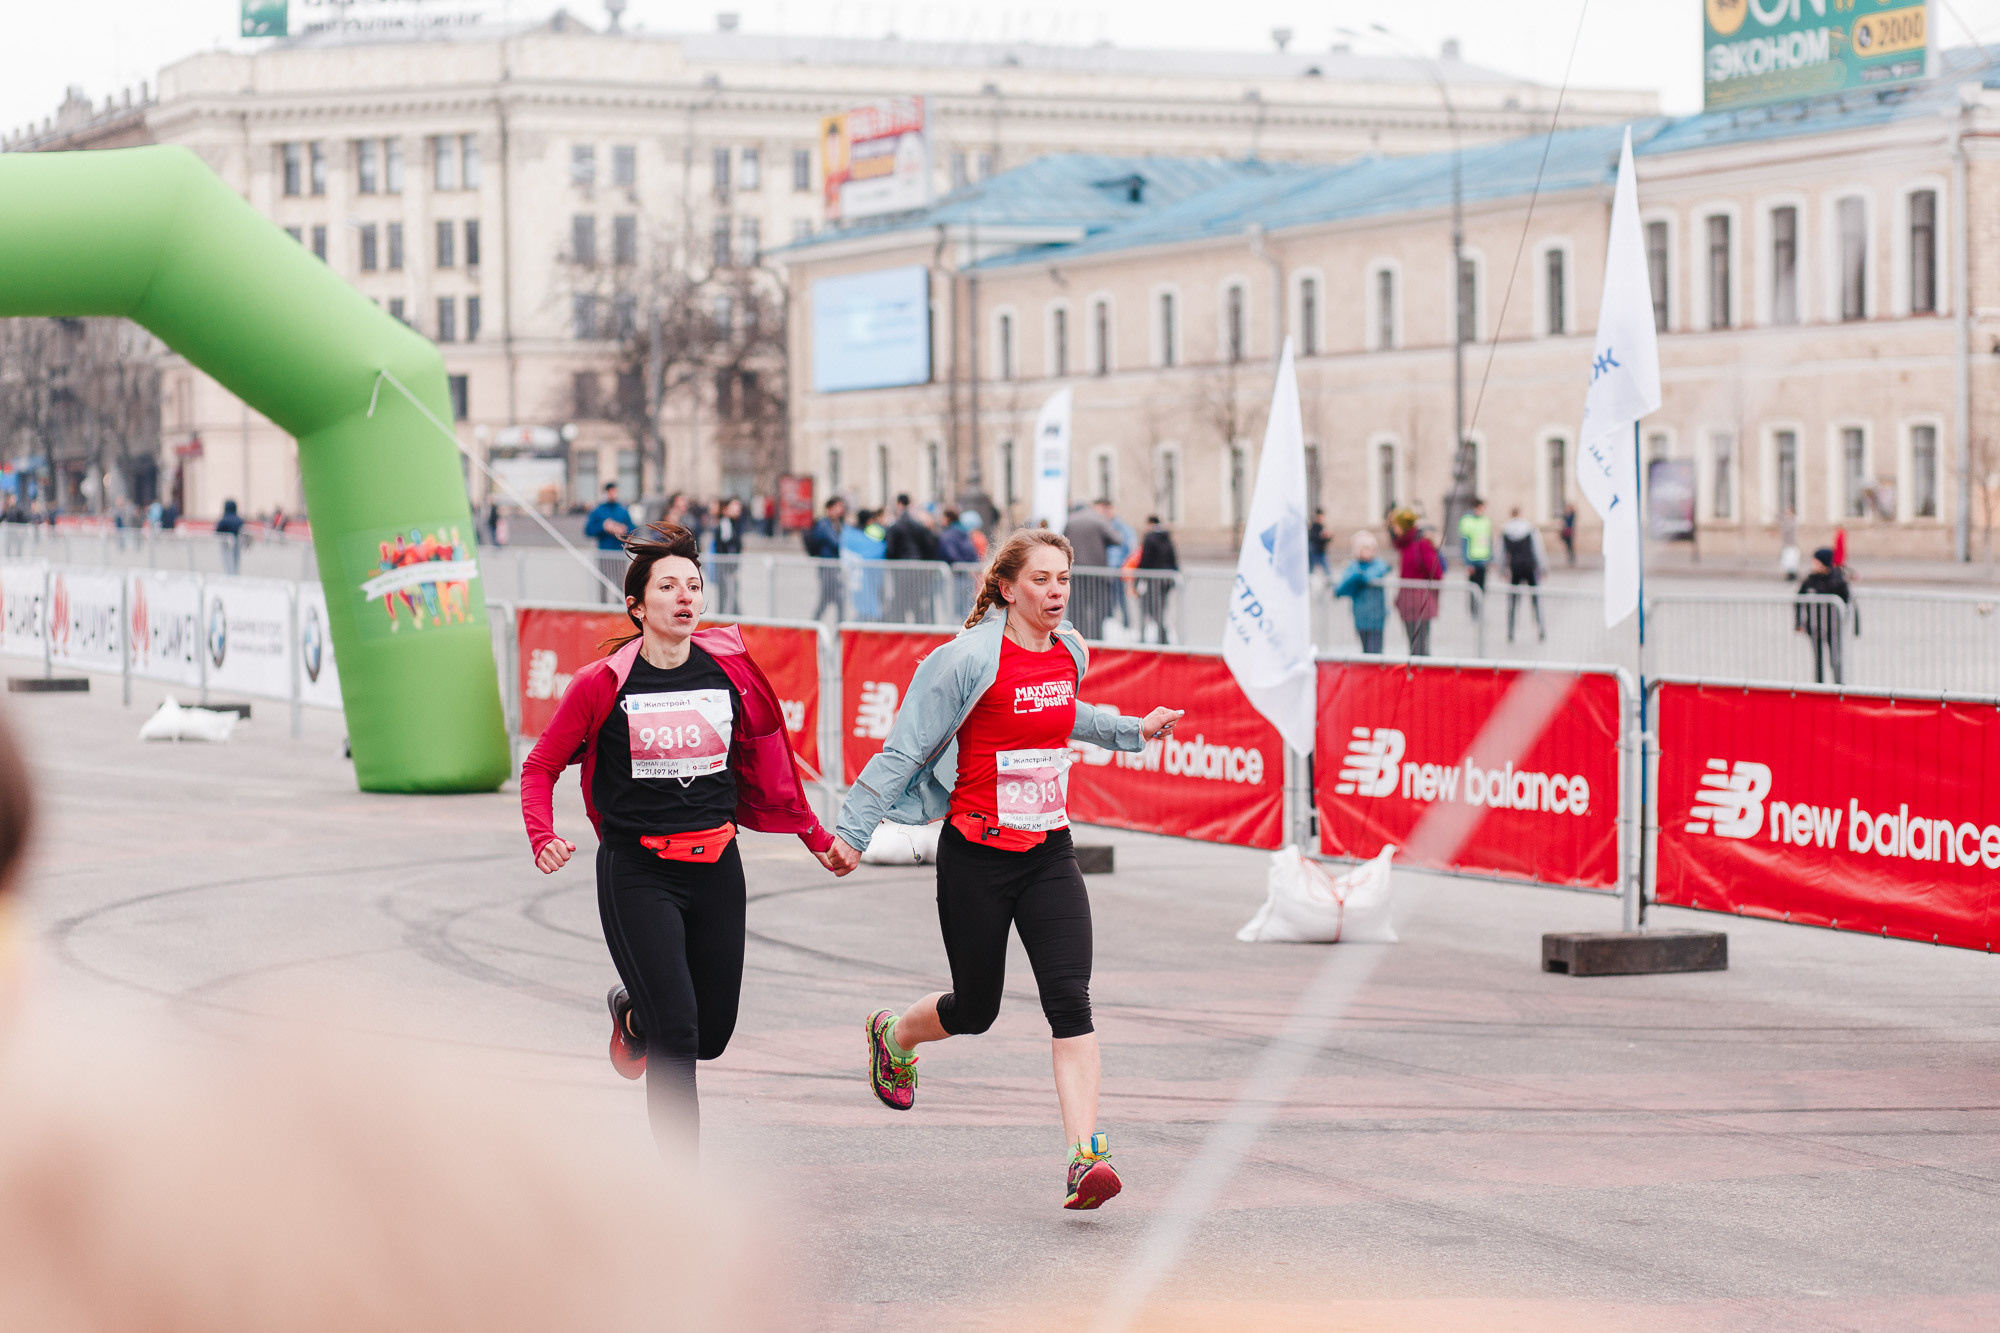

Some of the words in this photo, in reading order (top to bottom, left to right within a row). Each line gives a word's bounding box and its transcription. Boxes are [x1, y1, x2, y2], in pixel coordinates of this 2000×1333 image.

[643, 699, 691, 708] Жилстрой-1
[639, 724, 702, 751] 9313
[1164, 732, 1264, 785] balance
[1005, 780, 1057, 805] 9313
[1402, 762, 1461, 803] new
[1464, 756, 1590, 816] balance
[1769, 801, 1842, 849] new
[1848, 797, 2000, 869] balance
